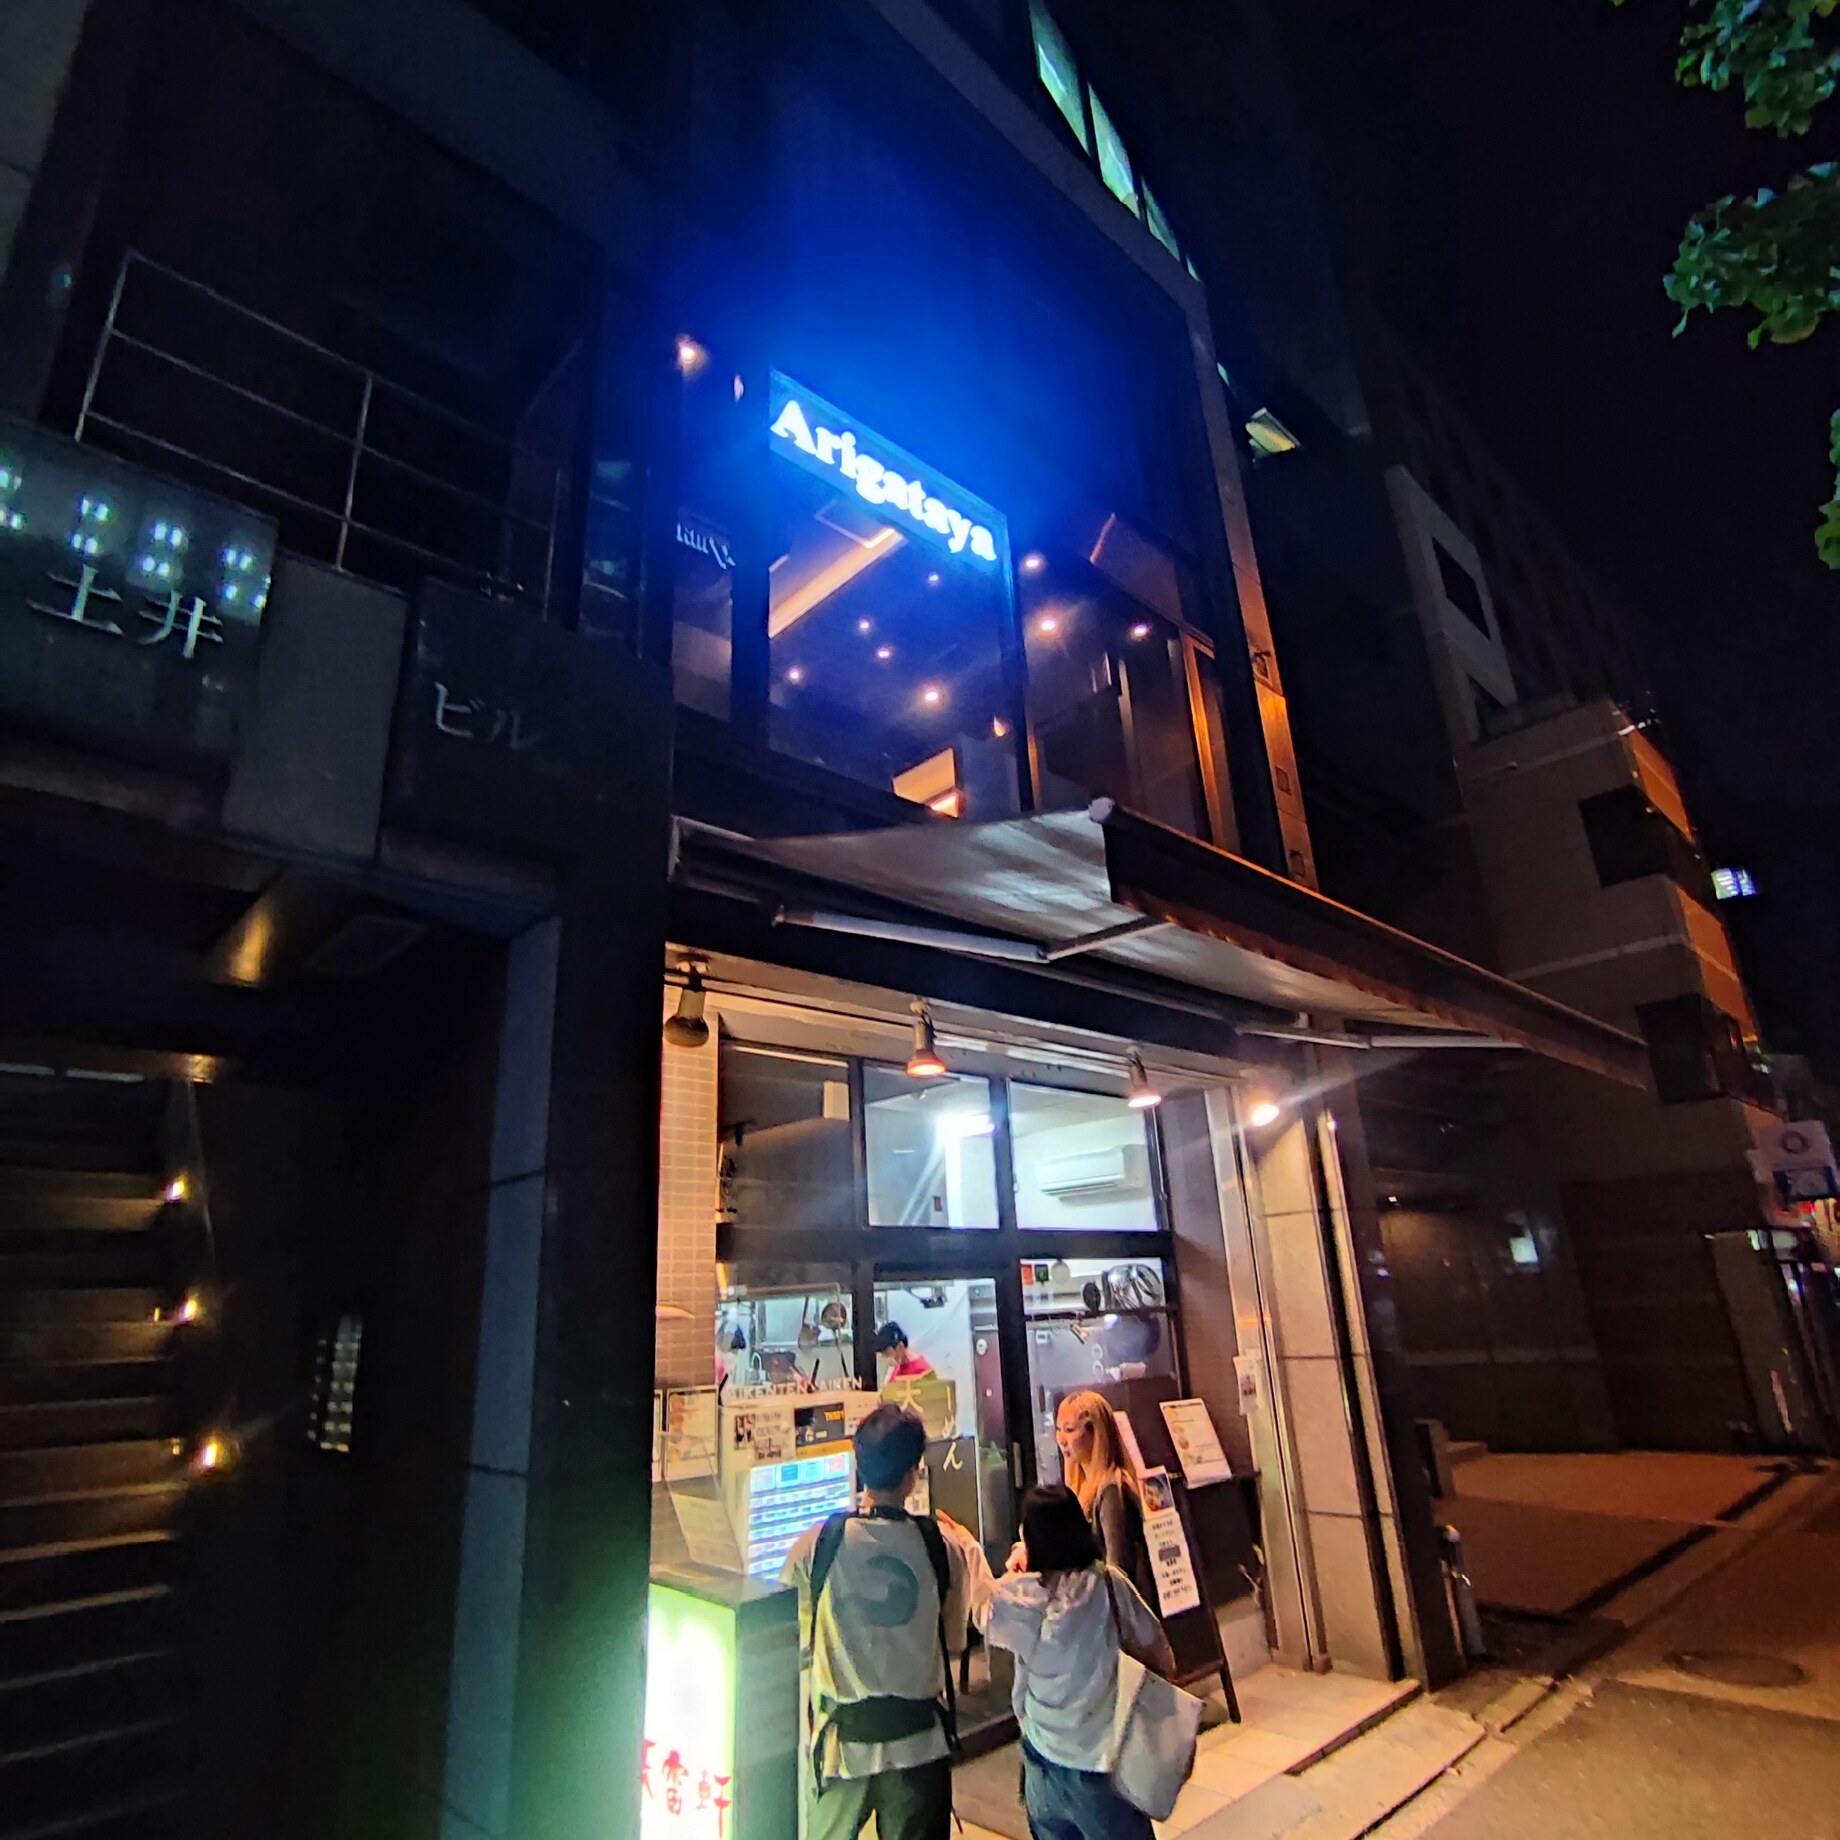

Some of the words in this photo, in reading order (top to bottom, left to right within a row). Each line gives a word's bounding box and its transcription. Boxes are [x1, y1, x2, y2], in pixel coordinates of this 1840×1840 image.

[769, 400, 998, 561] Arigataya
[27, 563, 224, 660] 土井
[433, 681, 547, 750] ビル
